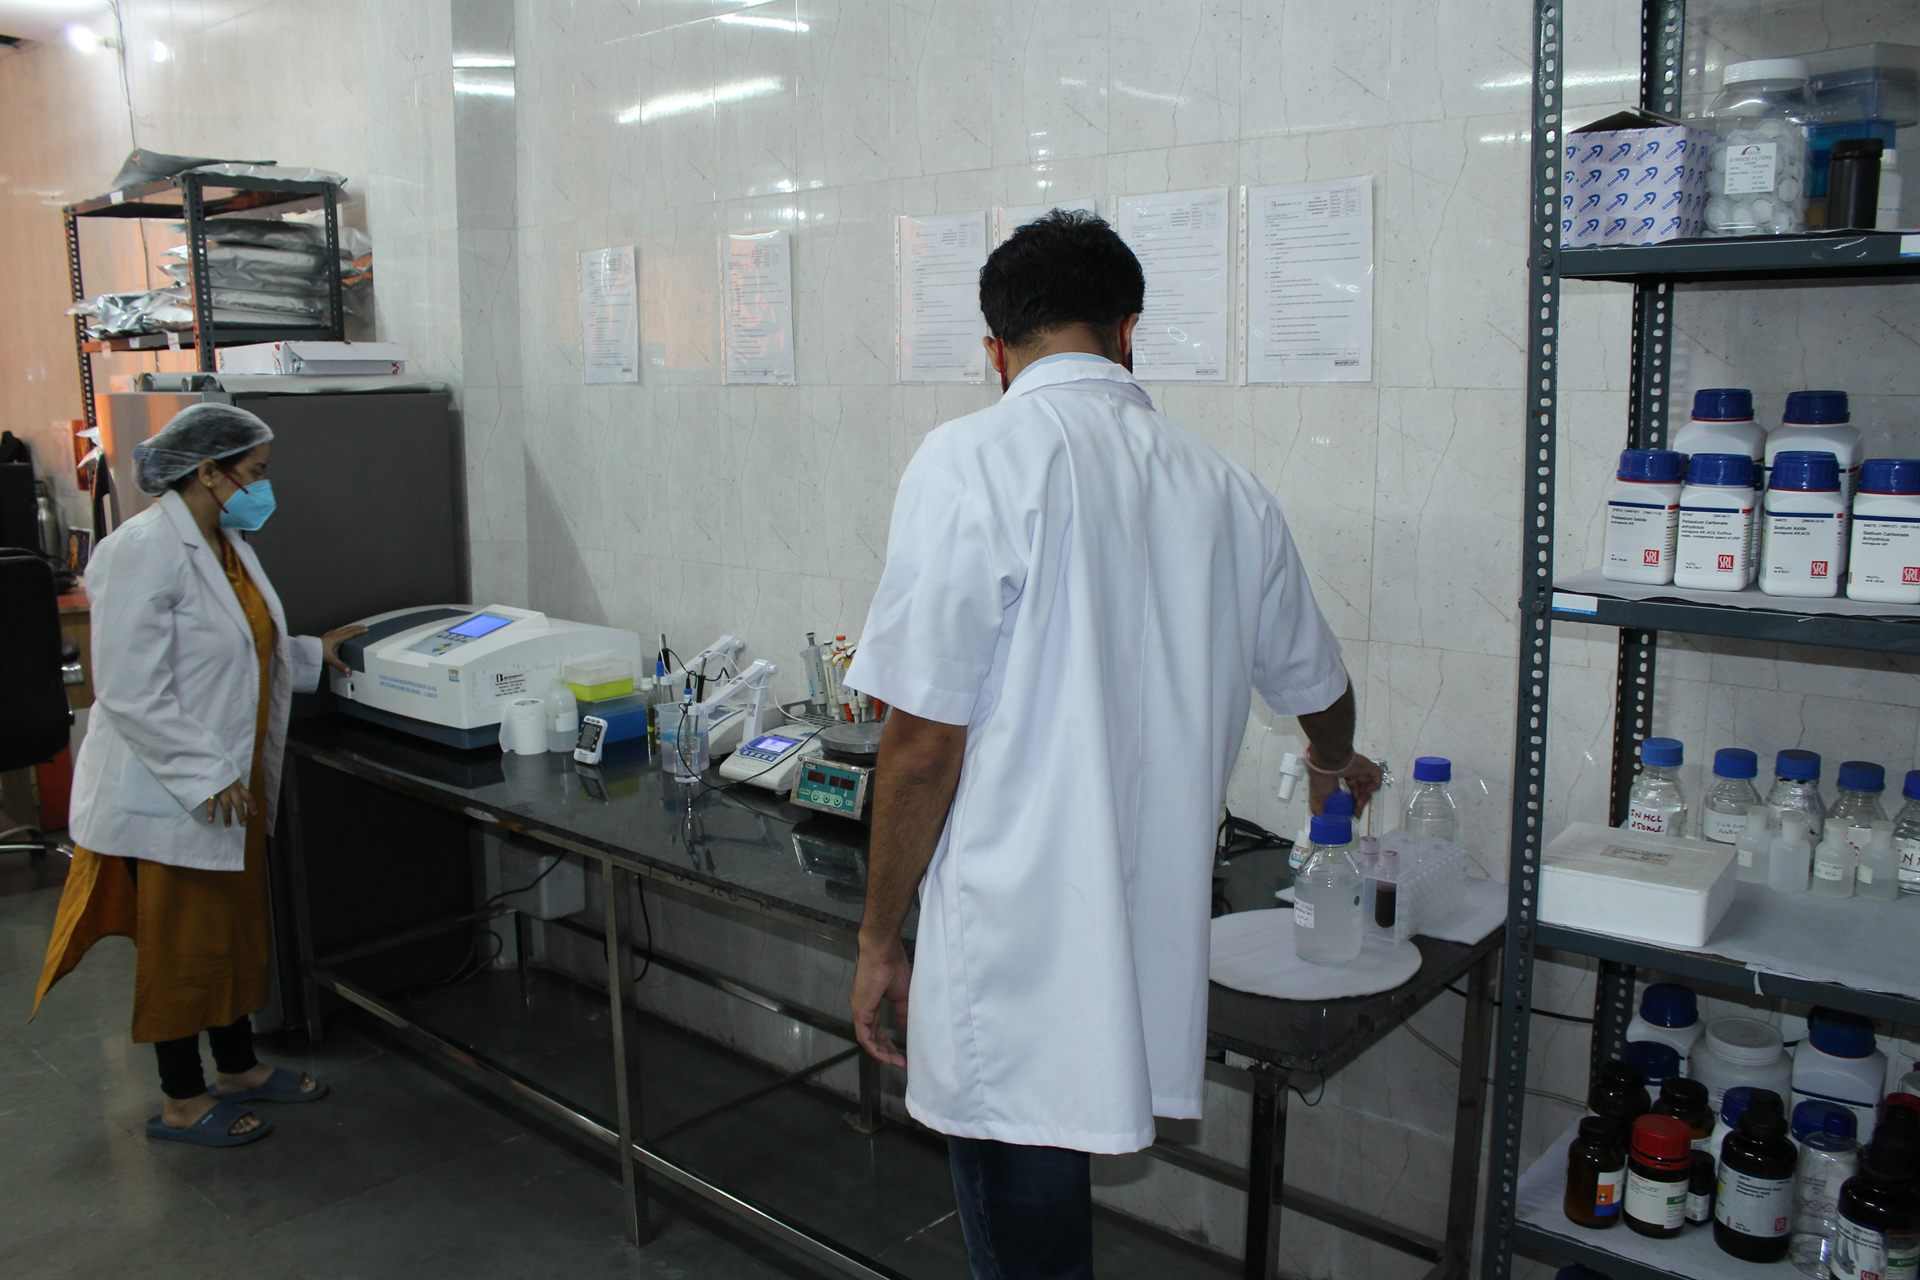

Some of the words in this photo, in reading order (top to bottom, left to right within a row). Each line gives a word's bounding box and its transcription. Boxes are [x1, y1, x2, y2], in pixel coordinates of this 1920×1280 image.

[1645, 550, 1659, 564] SRL
[1719, 555, 1734, 569] SRL
[1812, 561, 1828, 575] SRL
[1904, 568, 1919, 581] SRL
